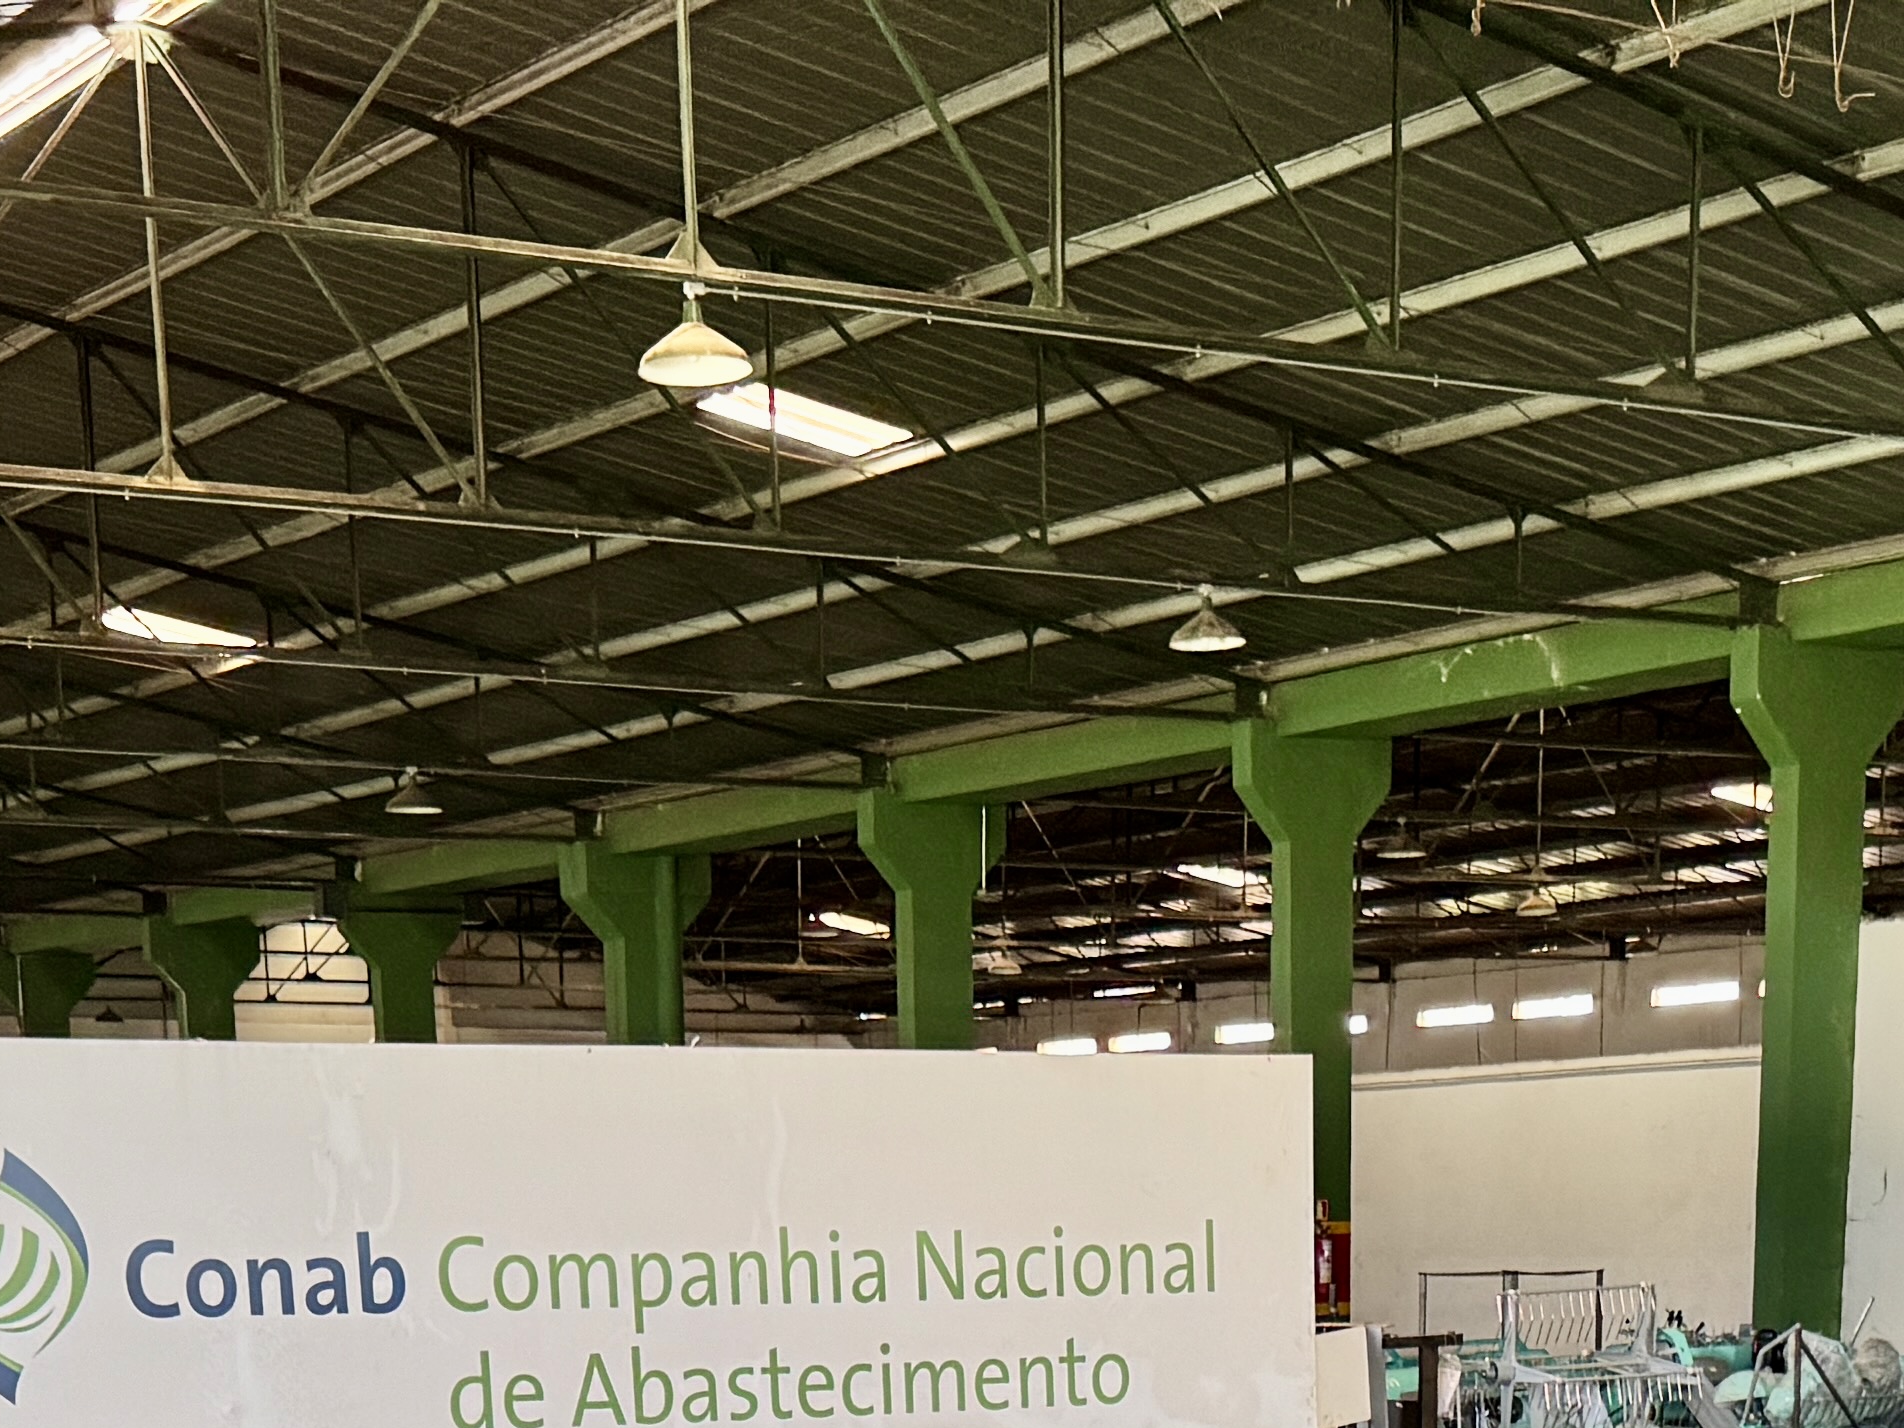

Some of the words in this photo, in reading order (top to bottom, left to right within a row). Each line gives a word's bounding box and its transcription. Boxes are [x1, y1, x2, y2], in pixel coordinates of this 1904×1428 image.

[125, 1231, 407, 1320] Conab
[436, 1226, 888, 1333] Companhia
[914, 1218, 1217, 1301] Nacional
[574, 1339, 1132, 1428] Abastecimento
